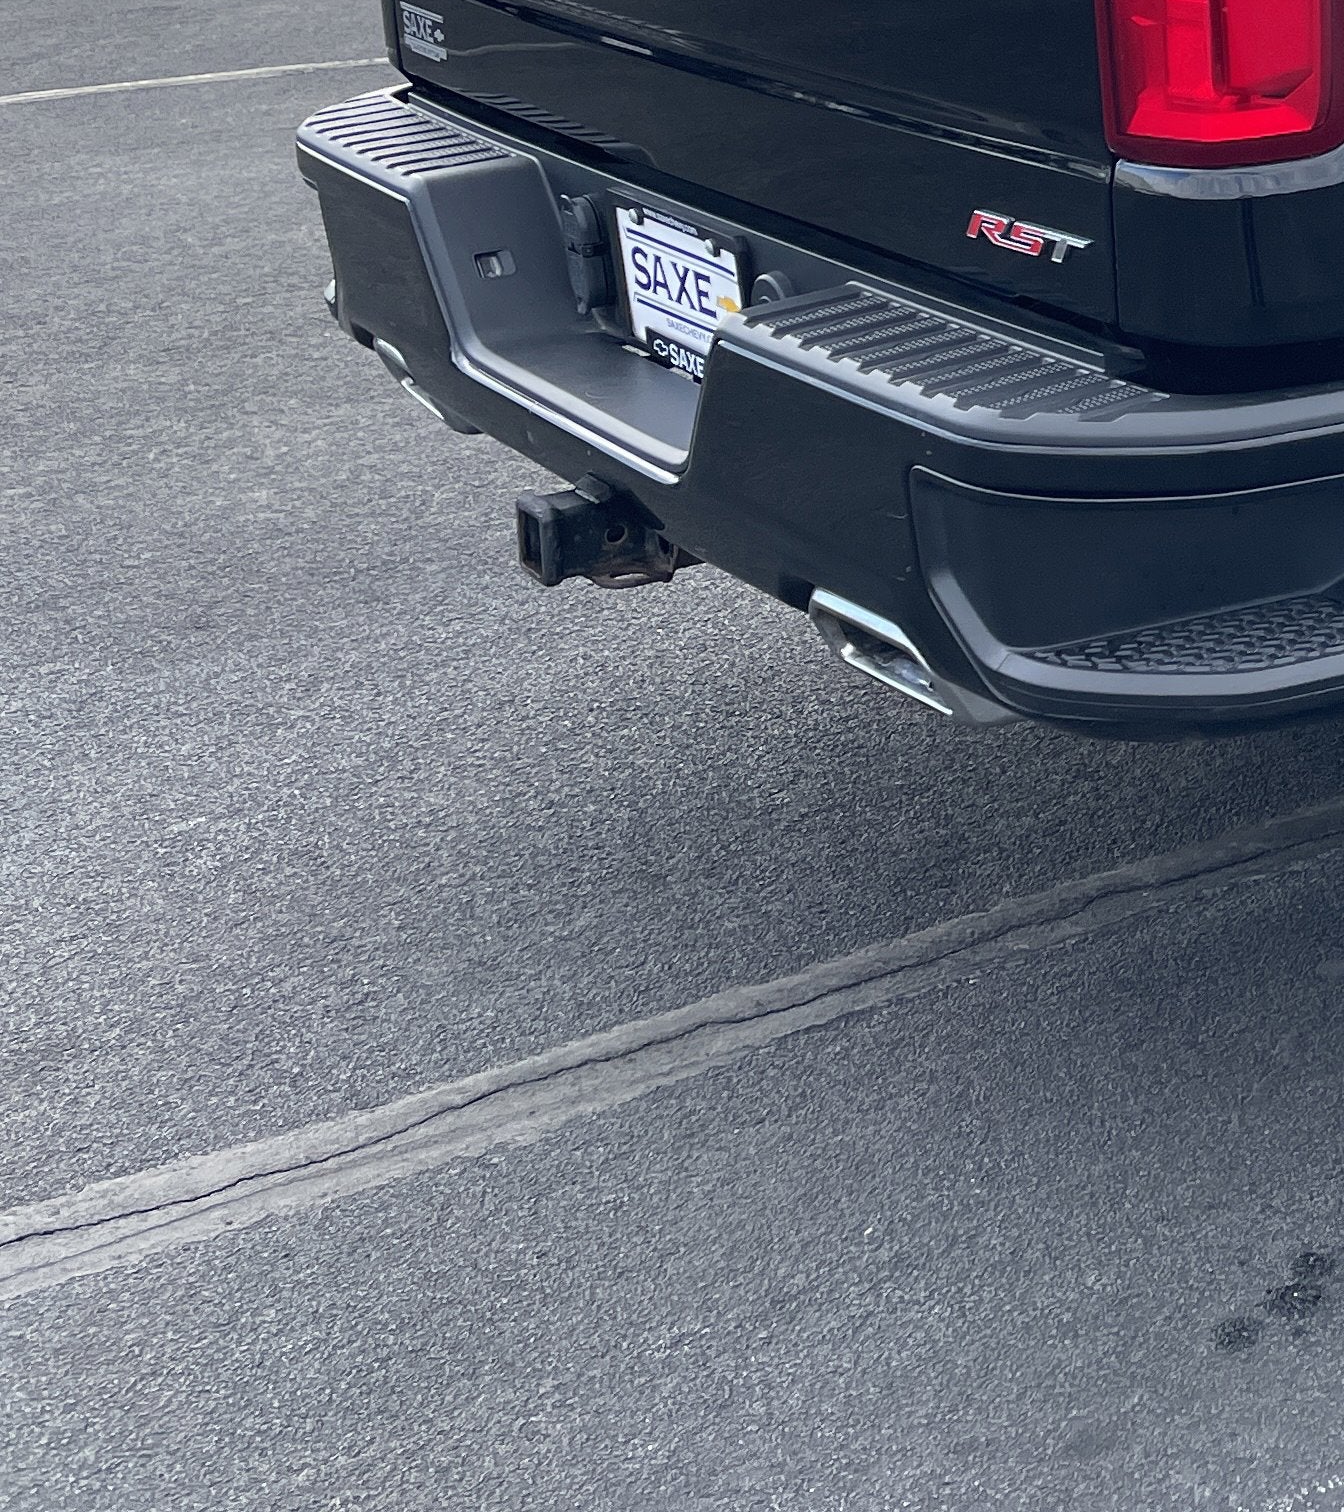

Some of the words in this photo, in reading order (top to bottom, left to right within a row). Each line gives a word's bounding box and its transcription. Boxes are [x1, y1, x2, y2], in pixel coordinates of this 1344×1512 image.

[403, 10, 435, 43] SAXE
[966, 209, 1095, 264] RST
[631, 246, 717, 319] SAXE
[668, 343, 705, 379] SAXE
